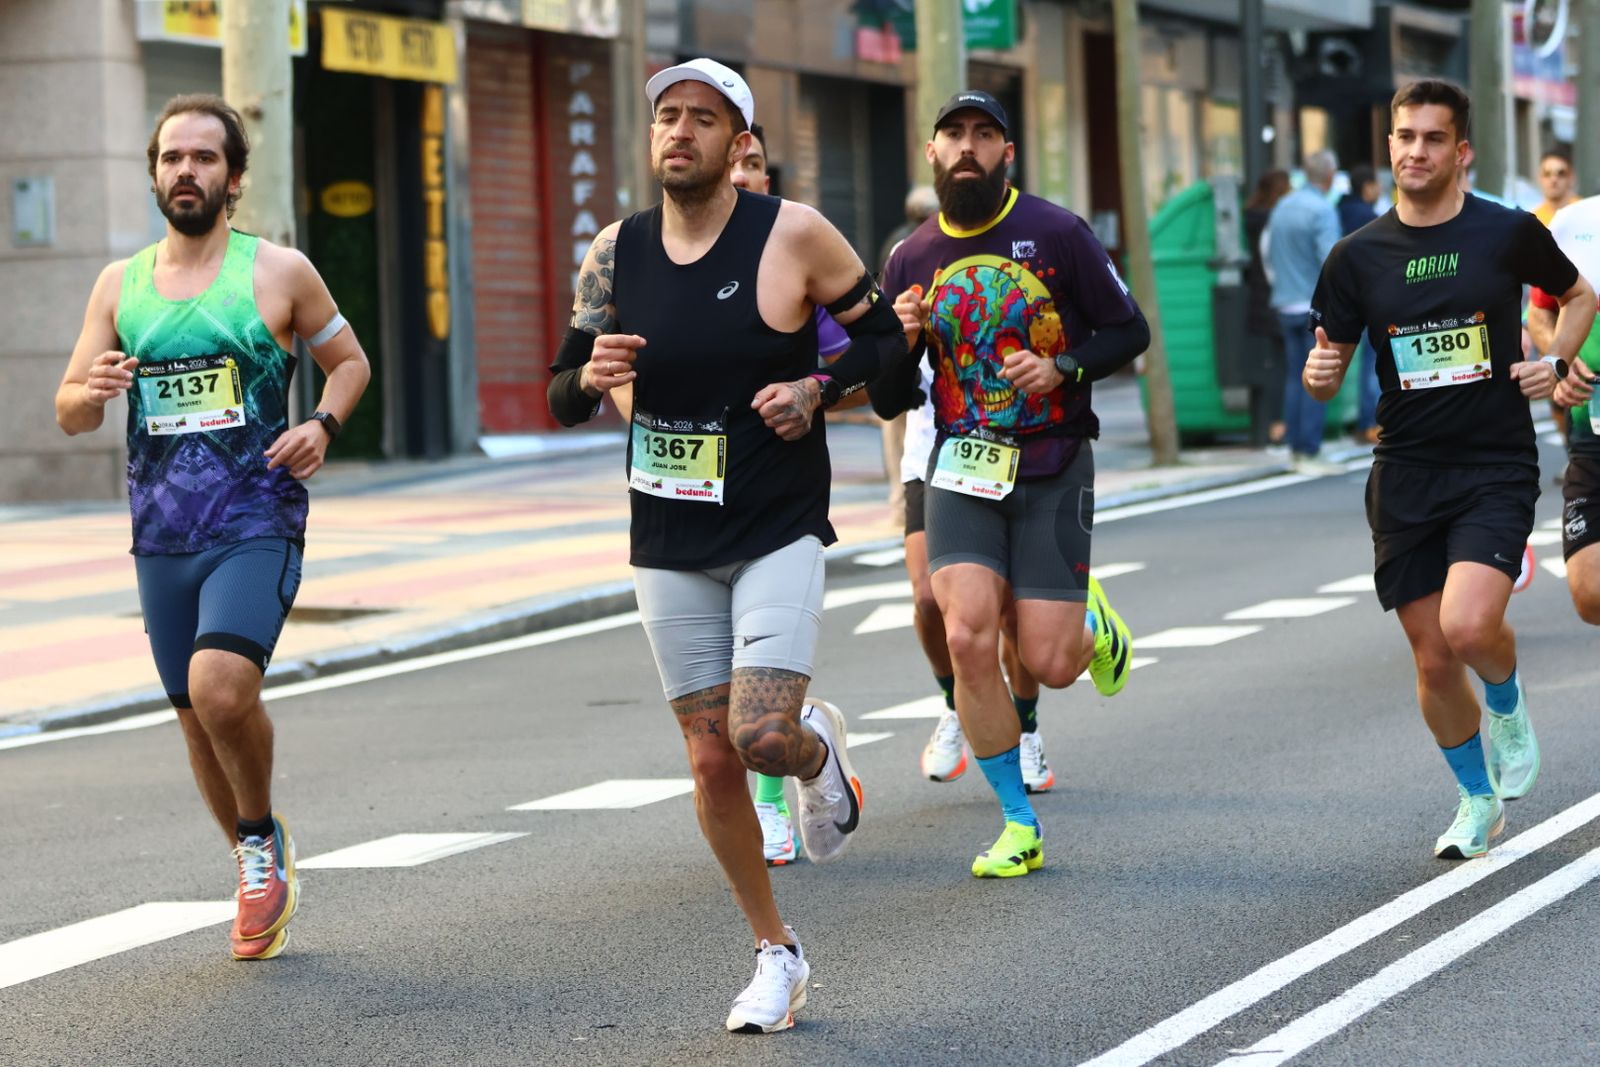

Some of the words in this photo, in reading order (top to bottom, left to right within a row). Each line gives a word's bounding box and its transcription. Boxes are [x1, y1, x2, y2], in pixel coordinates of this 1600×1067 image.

[1405, 252, 1459, 278] GORUN
[1440, 318, 1458, 327] 2026
[1411, 332, 1470, 356] 1380
[189, 359, 208, 368] 2026
[156, 373, 219, 399] 2137
[200, 417, 236, 428] bedunia
[673, 420, 694, 429] 2026
[643, 433, 704, 460] 1367
[953, 441, 1001, 464] 1975
[675, 487, 713, 497] bedunia
[971, 485, 1002, 497] bedunia
